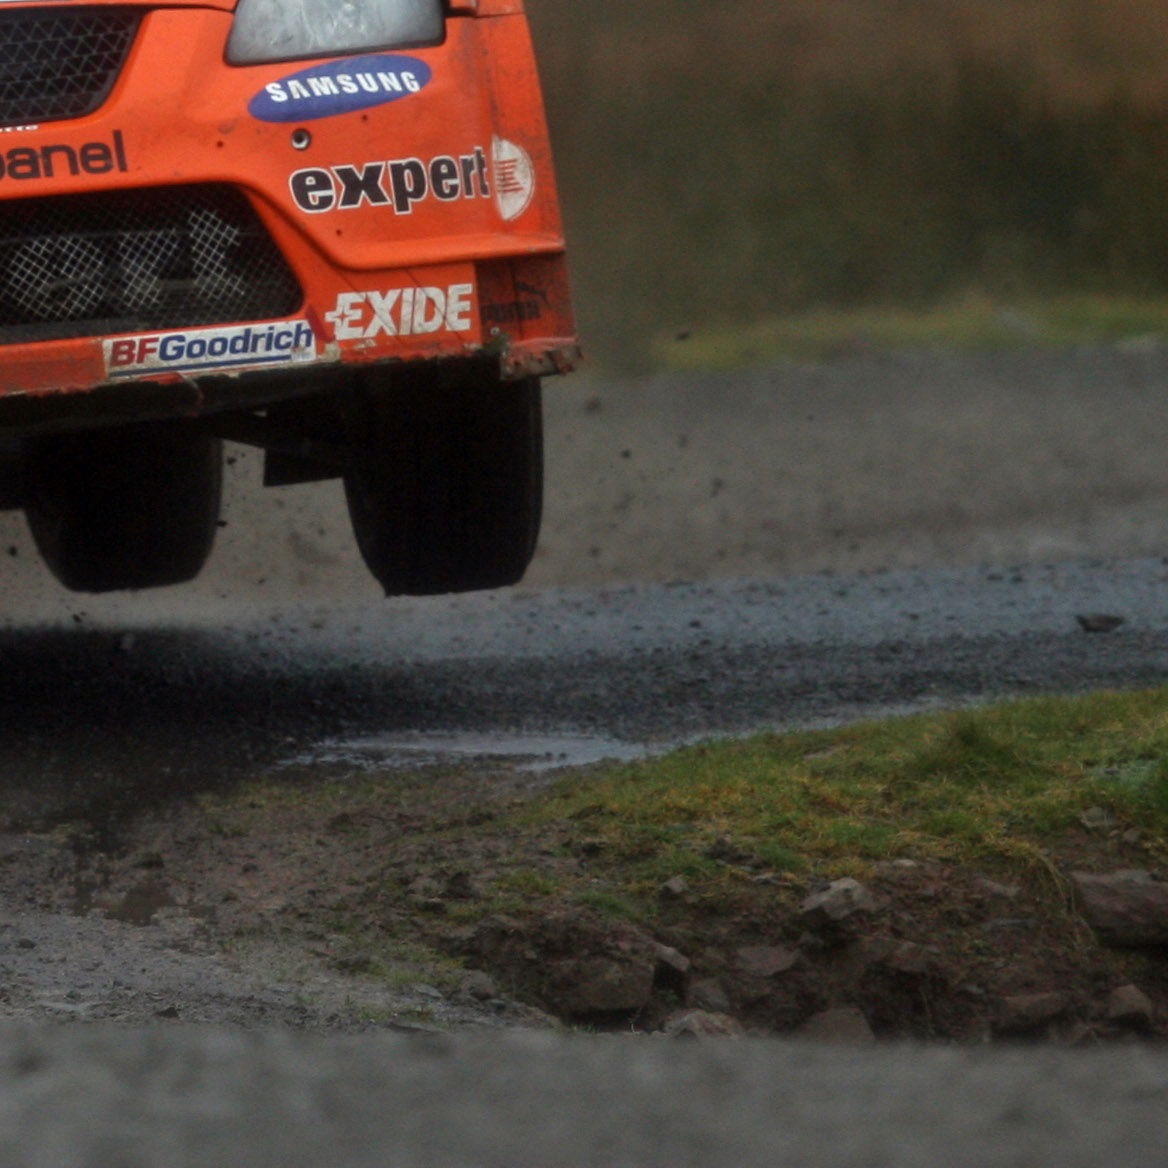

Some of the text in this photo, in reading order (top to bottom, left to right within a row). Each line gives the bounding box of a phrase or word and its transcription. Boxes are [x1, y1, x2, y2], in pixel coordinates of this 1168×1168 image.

[265, 71, 421, 102] SAMSUNG
[289, 146, 490, 215] expert
[326, 283, 473, 342] EXIDE
[109, 323, 313, 367] BFGoodrich
